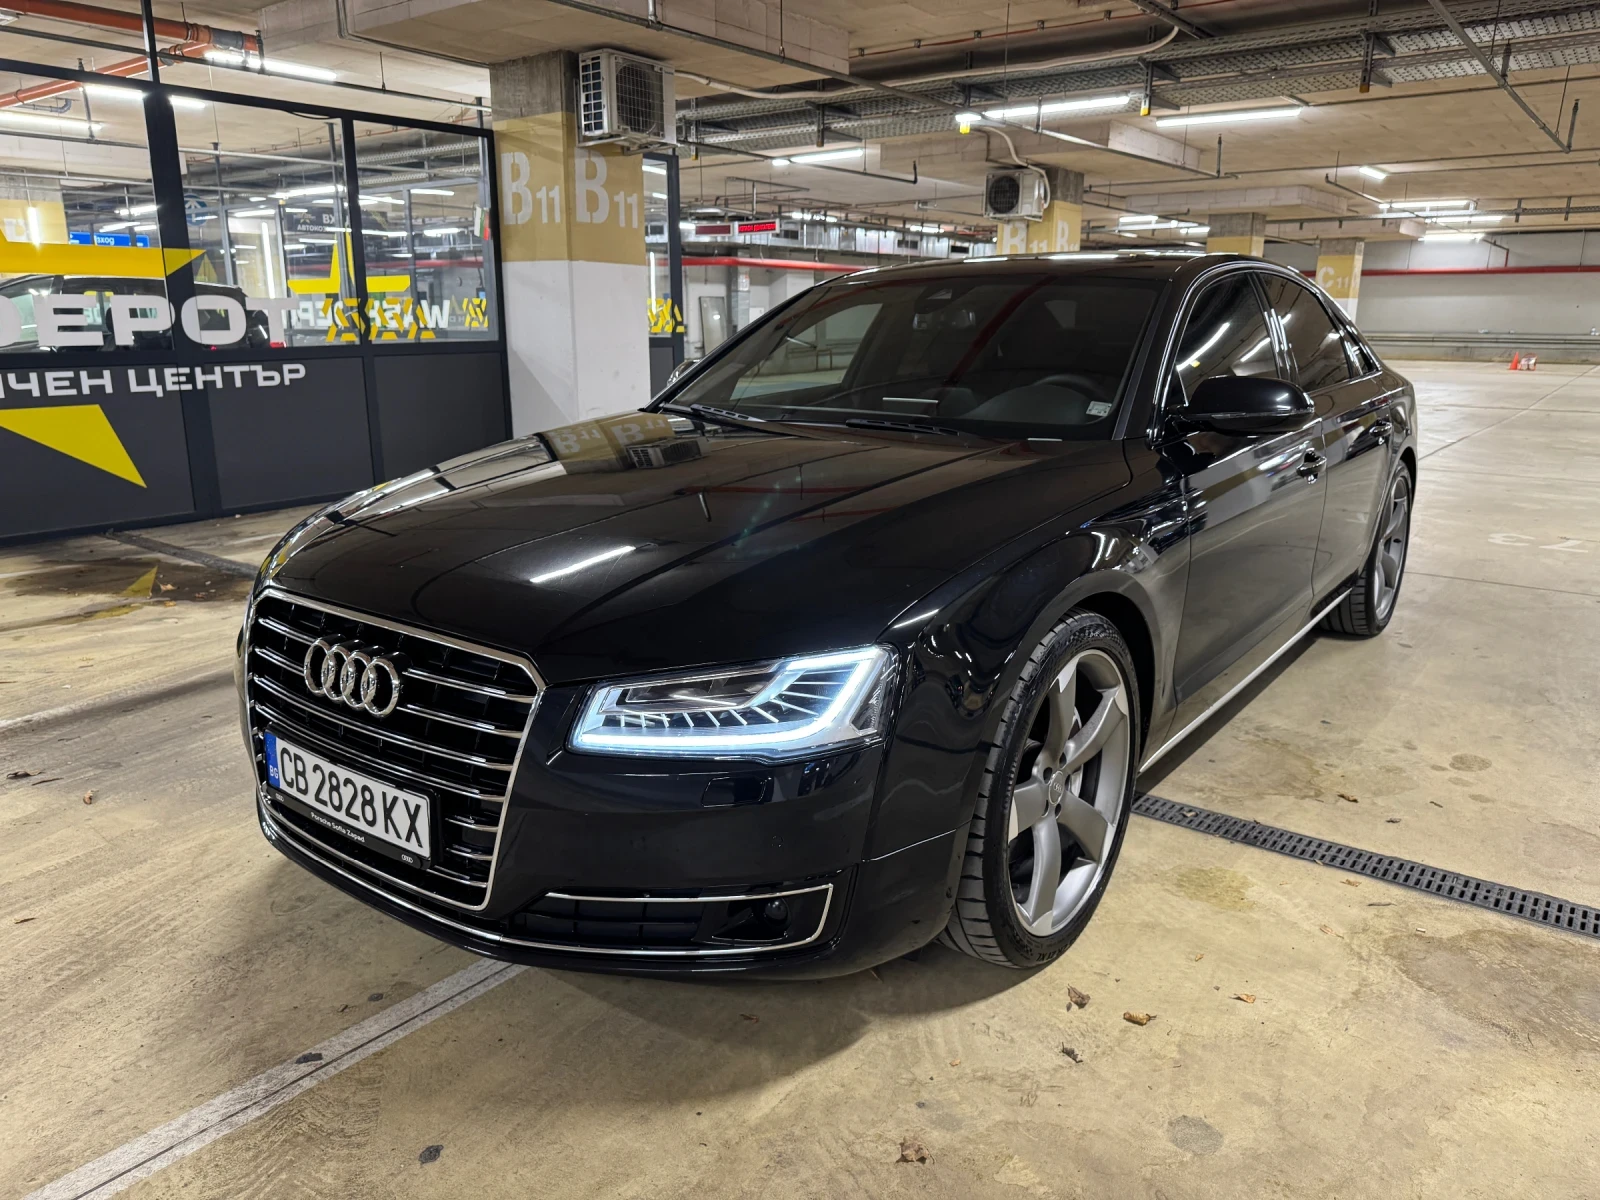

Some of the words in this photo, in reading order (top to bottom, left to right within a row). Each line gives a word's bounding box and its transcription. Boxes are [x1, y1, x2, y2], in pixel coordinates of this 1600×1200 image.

[0, 370, 114, 399] ЧЕН
[128, 363, 306, 398] ЦЕНТЪР
[269, 764, 279, 779] BG
[310, 811, 331, 827] Porsche
[331, 822, 346, 834] Sofia
